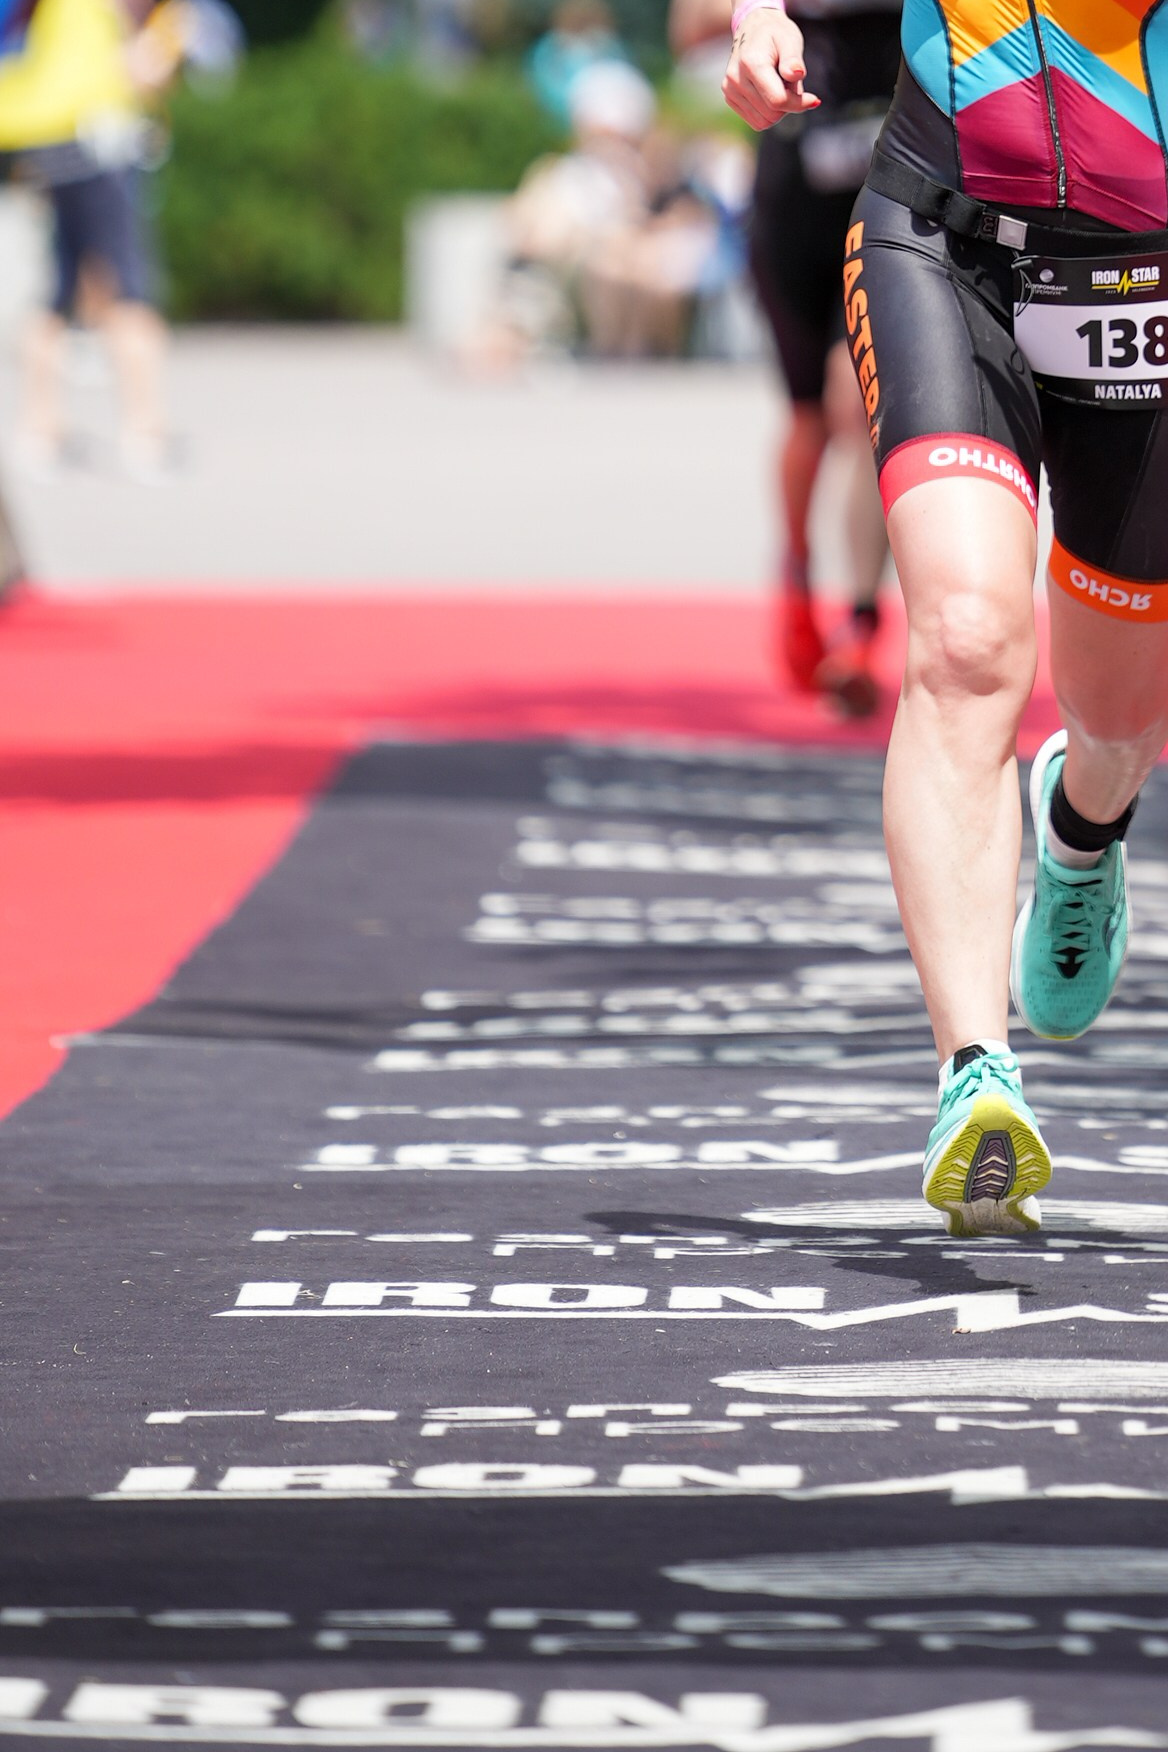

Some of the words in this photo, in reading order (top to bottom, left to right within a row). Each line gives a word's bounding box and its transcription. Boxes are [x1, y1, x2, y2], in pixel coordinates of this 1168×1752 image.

[1091, 268, 1120, 285] IRON
[1131, 266, 1160, 283] STAR
[1094, 383, 1163, 400] NATALYA
[928, 446, 1037, 513] ОНЯТНО
[1069, 569, 1152, 611] ЯСНО
[316, 1140, 839, 1165] IRON
[235, 1281, 826, 1310] IRON
[118, 1463, 805, 1493] IRON
